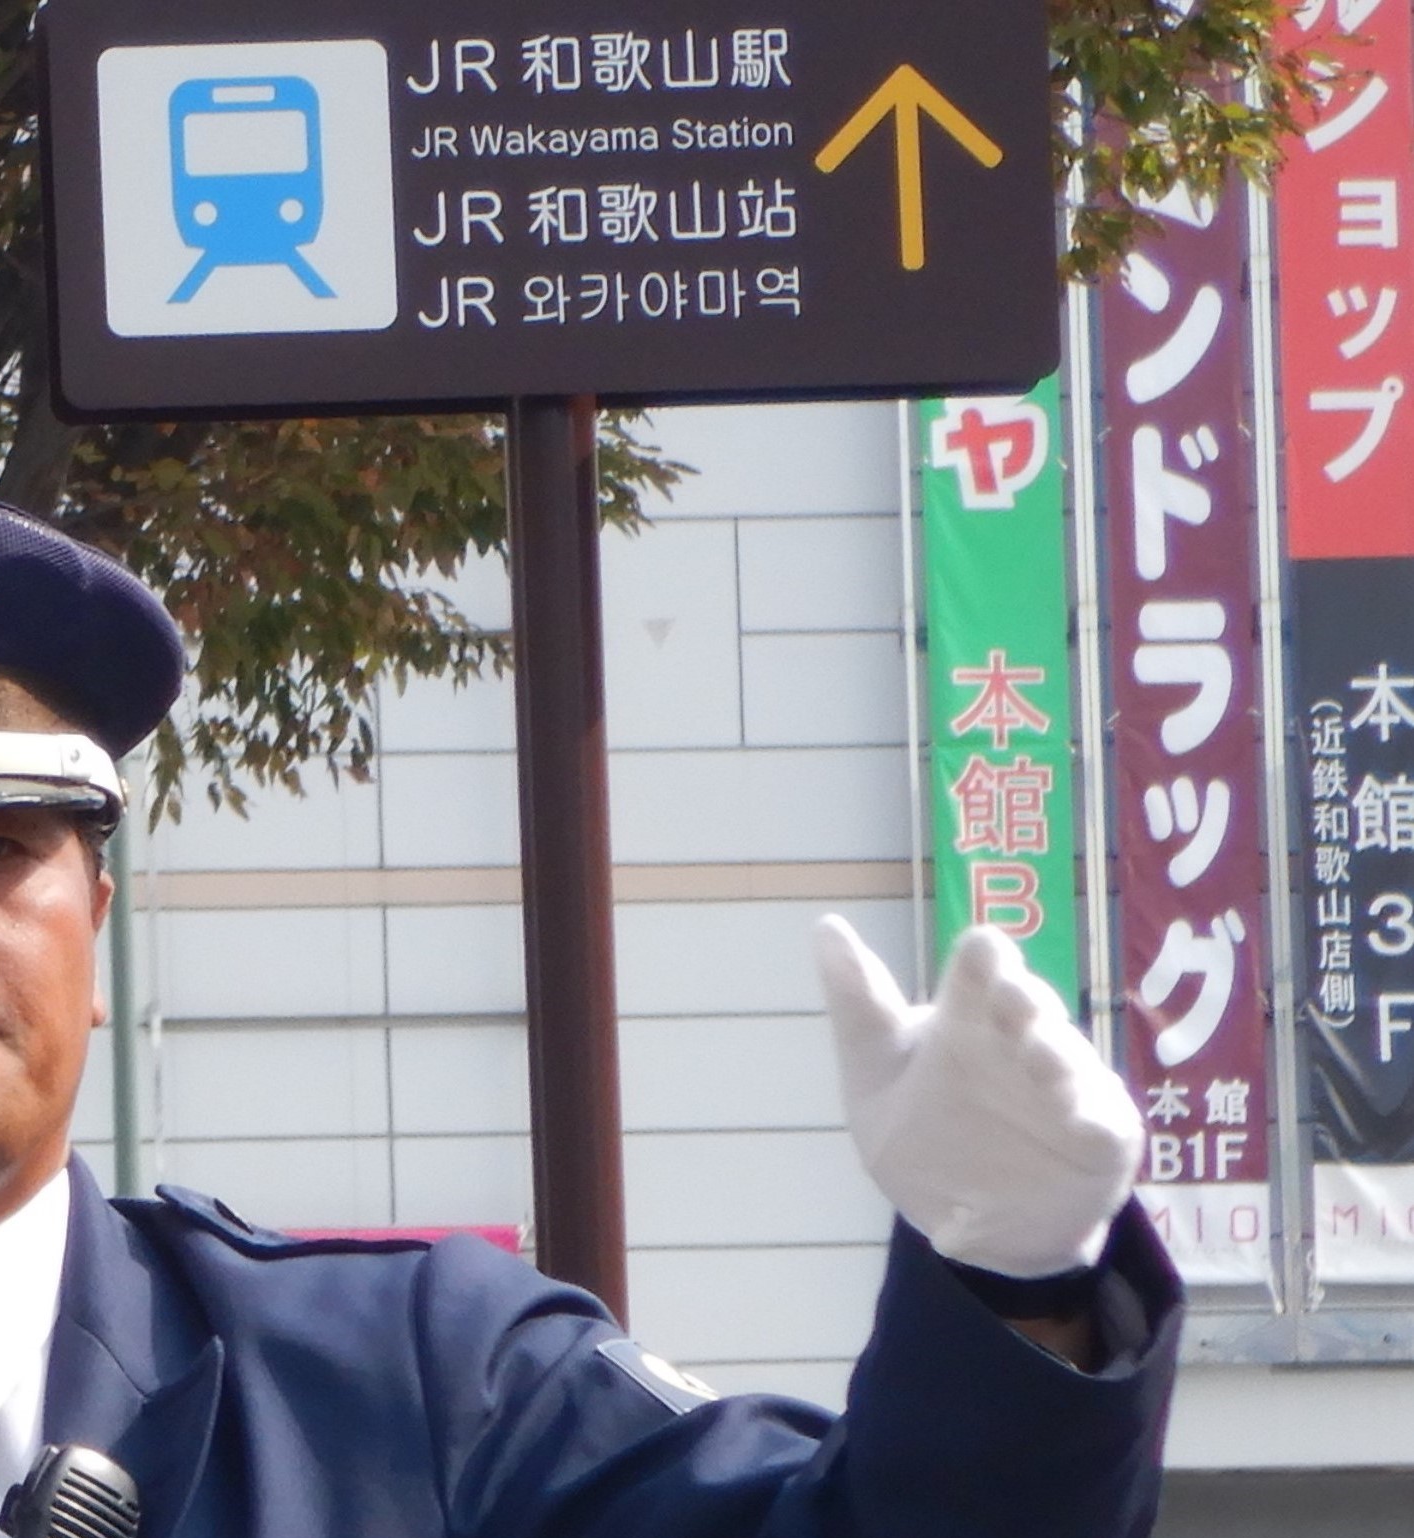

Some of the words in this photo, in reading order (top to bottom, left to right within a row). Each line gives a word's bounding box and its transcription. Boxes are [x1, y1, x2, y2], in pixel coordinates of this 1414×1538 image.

[407, 39, 499, 94] JR
[523, 29, 792, 92] 和歌山駅
[411, 126, 460, 160] JR
[471, 120, 660, 158] Wakayama
[671, 116, 794, 151] Station
[413, 190, 505, 248] JR
[528, 179, 797, 245] 和歌山站
[1290, 0, 1403, 484] ショップ
[418, 277, 497, 330] JR
[524, 267, 802, 325] 와카야마역
[1121, 130, 1244, 1067] ンドラッグ
[1151, 1131, 1247, 1181] B1F
[1332, 1205, 1414, 1236] MI
